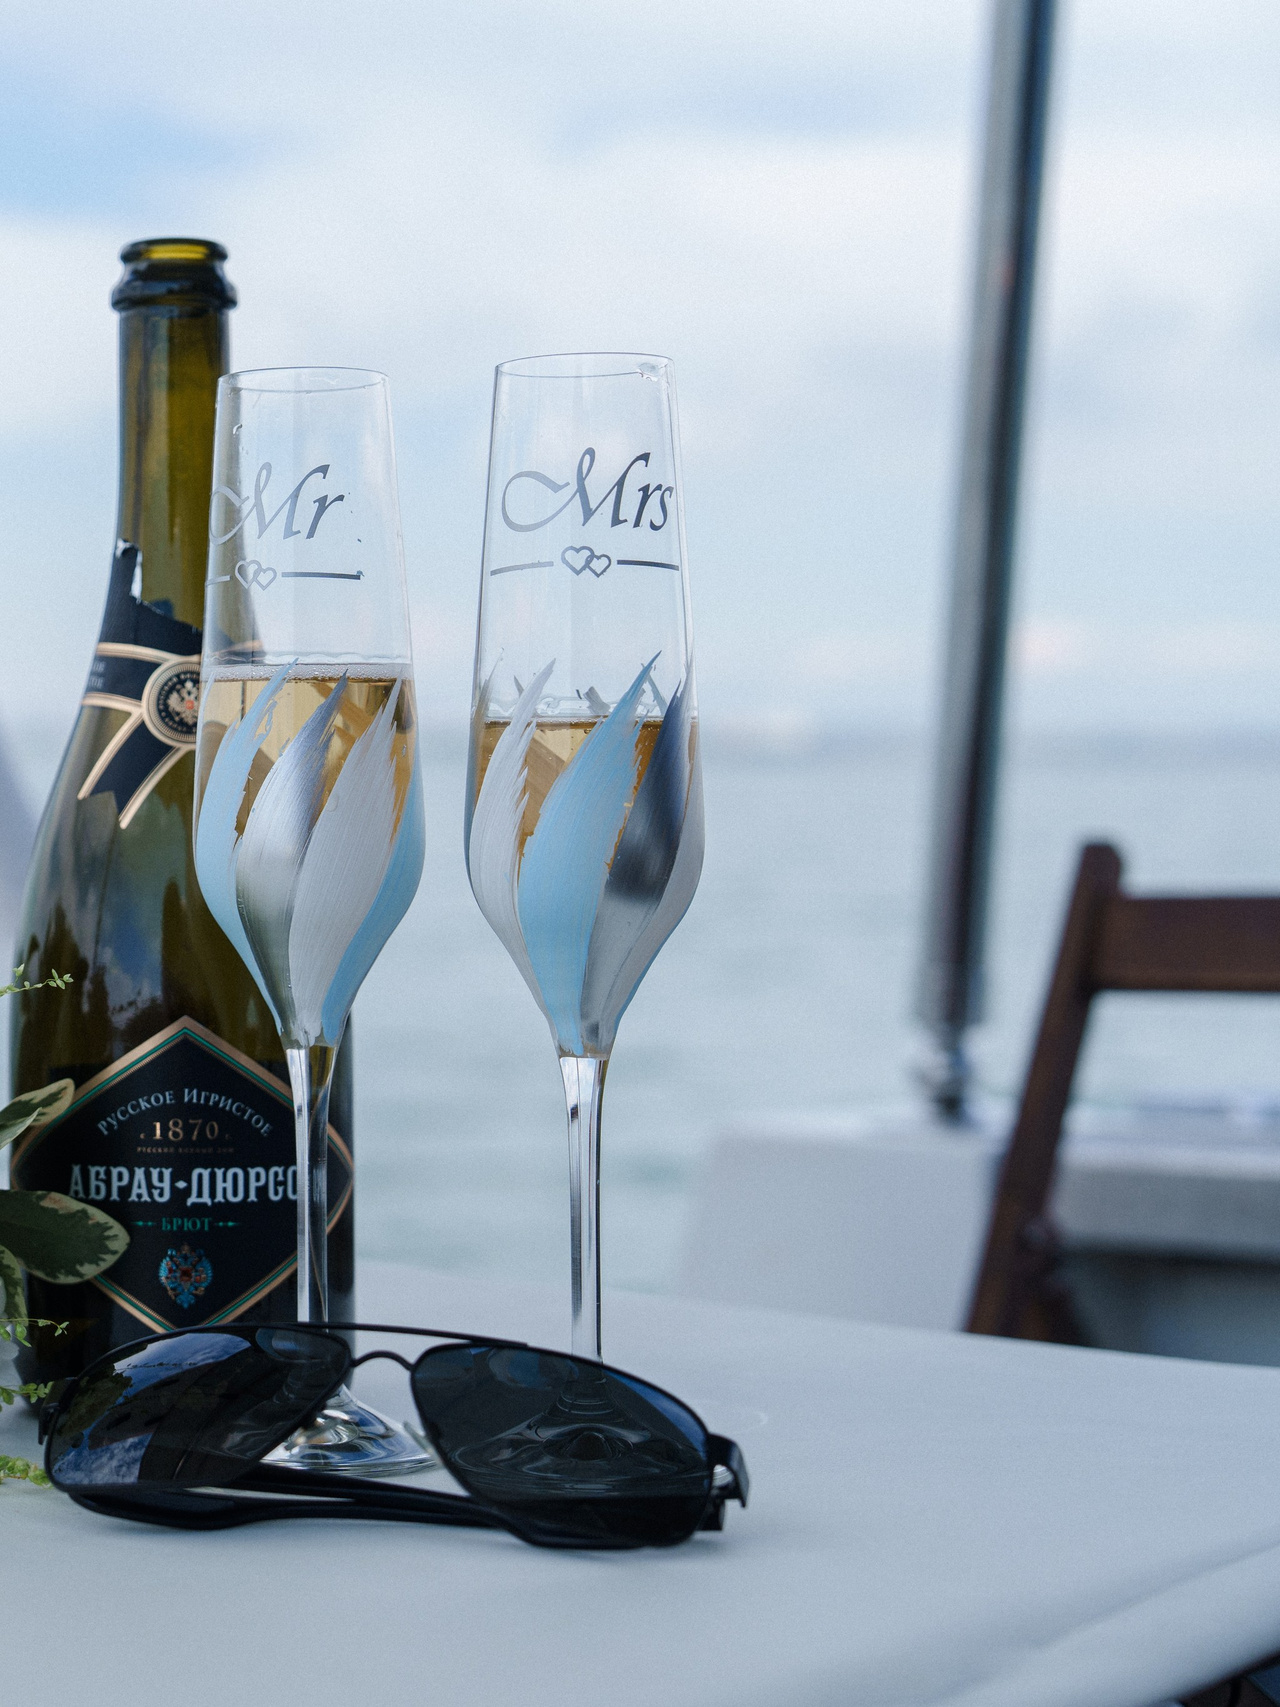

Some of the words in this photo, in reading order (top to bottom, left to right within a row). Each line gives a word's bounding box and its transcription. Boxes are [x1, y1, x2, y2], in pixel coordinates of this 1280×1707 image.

[209, 461, 345, 545] Mr
[501, 446, 674, 532] Mrs
[152, 1118, 220, 1142] 1870
[161, 1217, 213, 1232] БРЮТ
